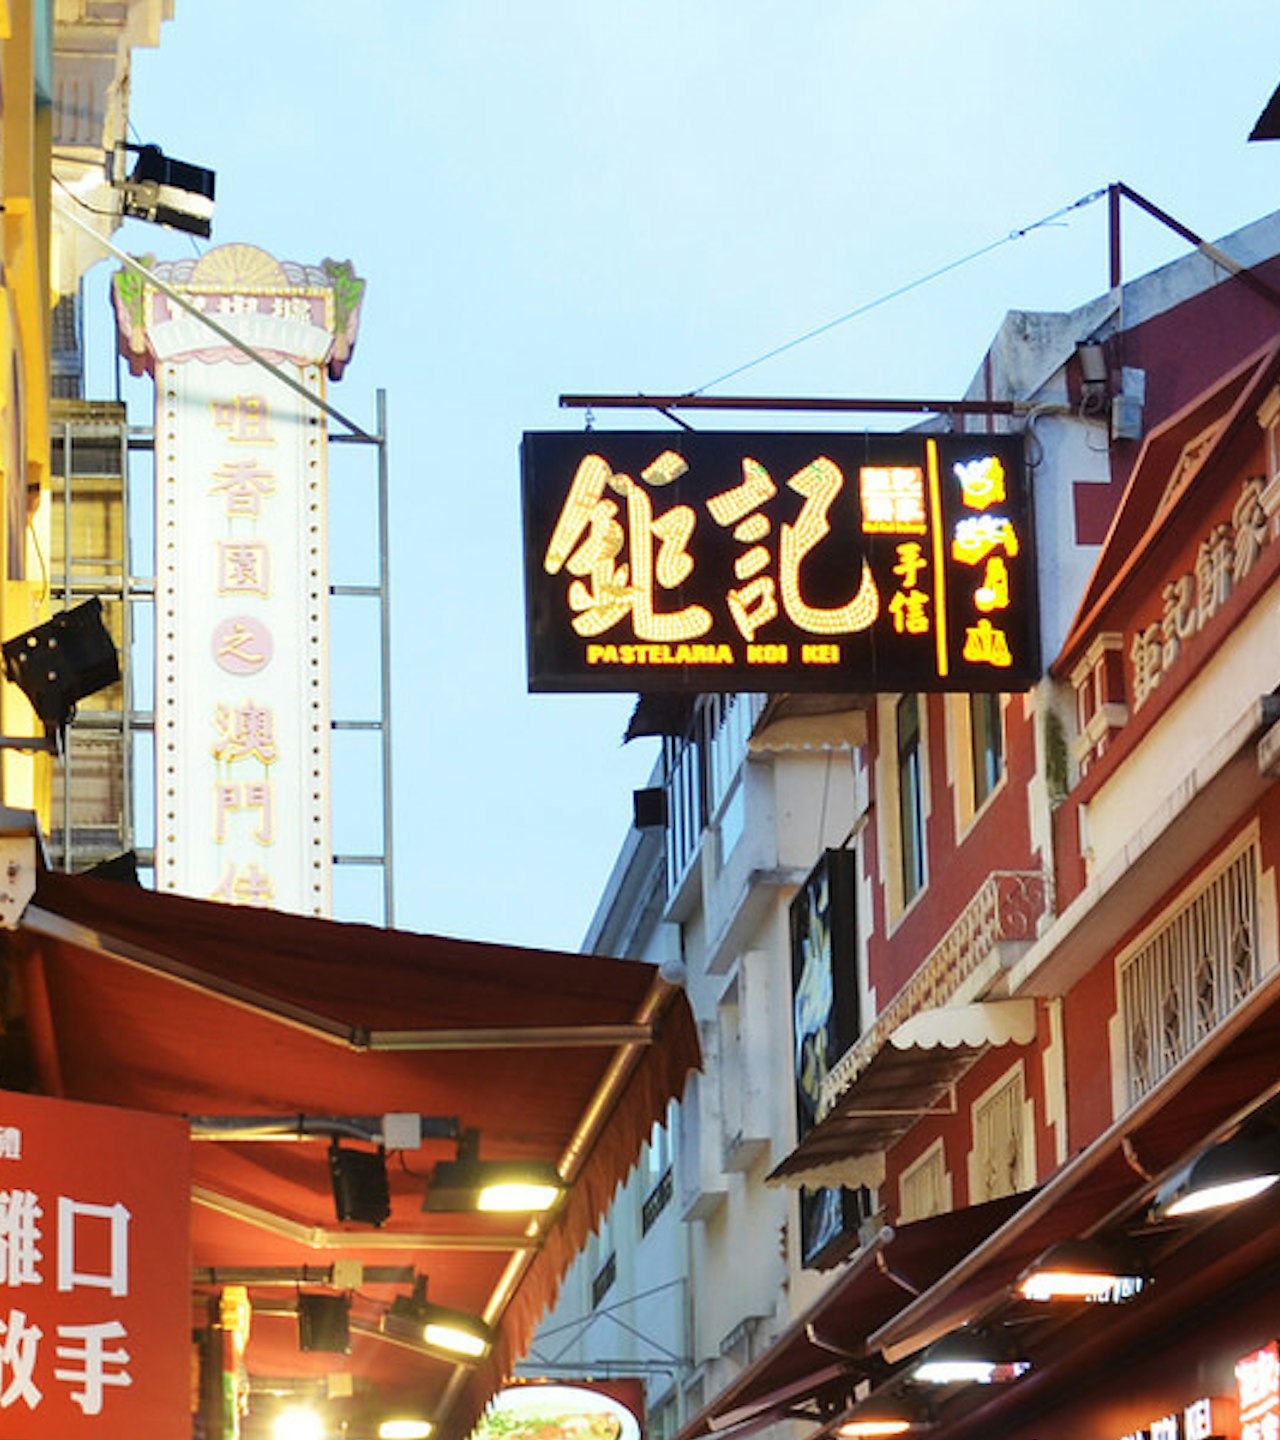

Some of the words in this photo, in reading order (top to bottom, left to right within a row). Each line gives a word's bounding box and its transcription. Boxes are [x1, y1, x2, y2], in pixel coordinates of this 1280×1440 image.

[543, 448, 880, 643] 鉅記
[888, 541, 930, 635] 手信
[586, 644, 735, 665] PASTELARIA
[746, 644, 789, 665] KOI
[801, 644, 841, 665] KEI
